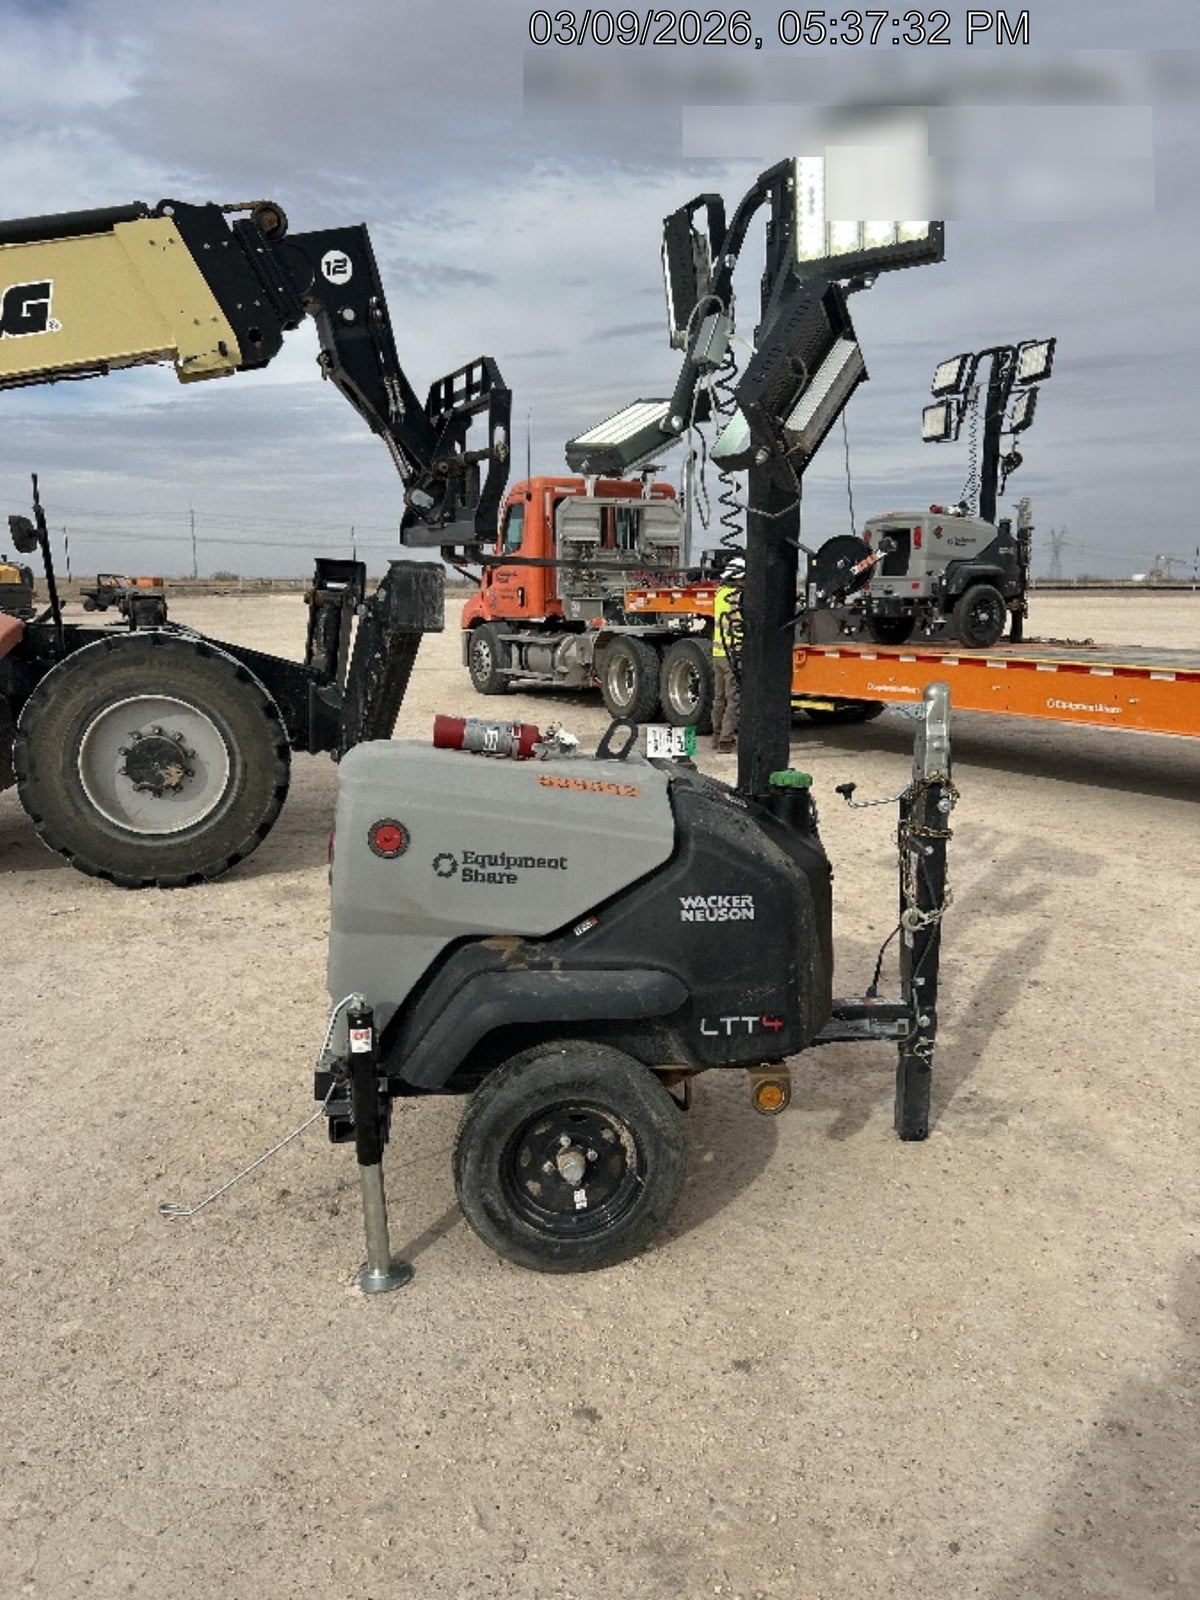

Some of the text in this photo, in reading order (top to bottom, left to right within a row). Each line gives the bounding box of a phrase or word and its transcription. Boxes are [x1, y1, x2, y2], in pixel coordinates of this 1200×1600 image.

[325, 258, 349, 276] 12
[462, 851, 567, 870] Equipment
[462, 867, 518, 884] Share
[679, 895, 755, 909] WACKER
[680, 908, 755, 922] NEUSON
[700, 1014, 783, 1036] LTT4
